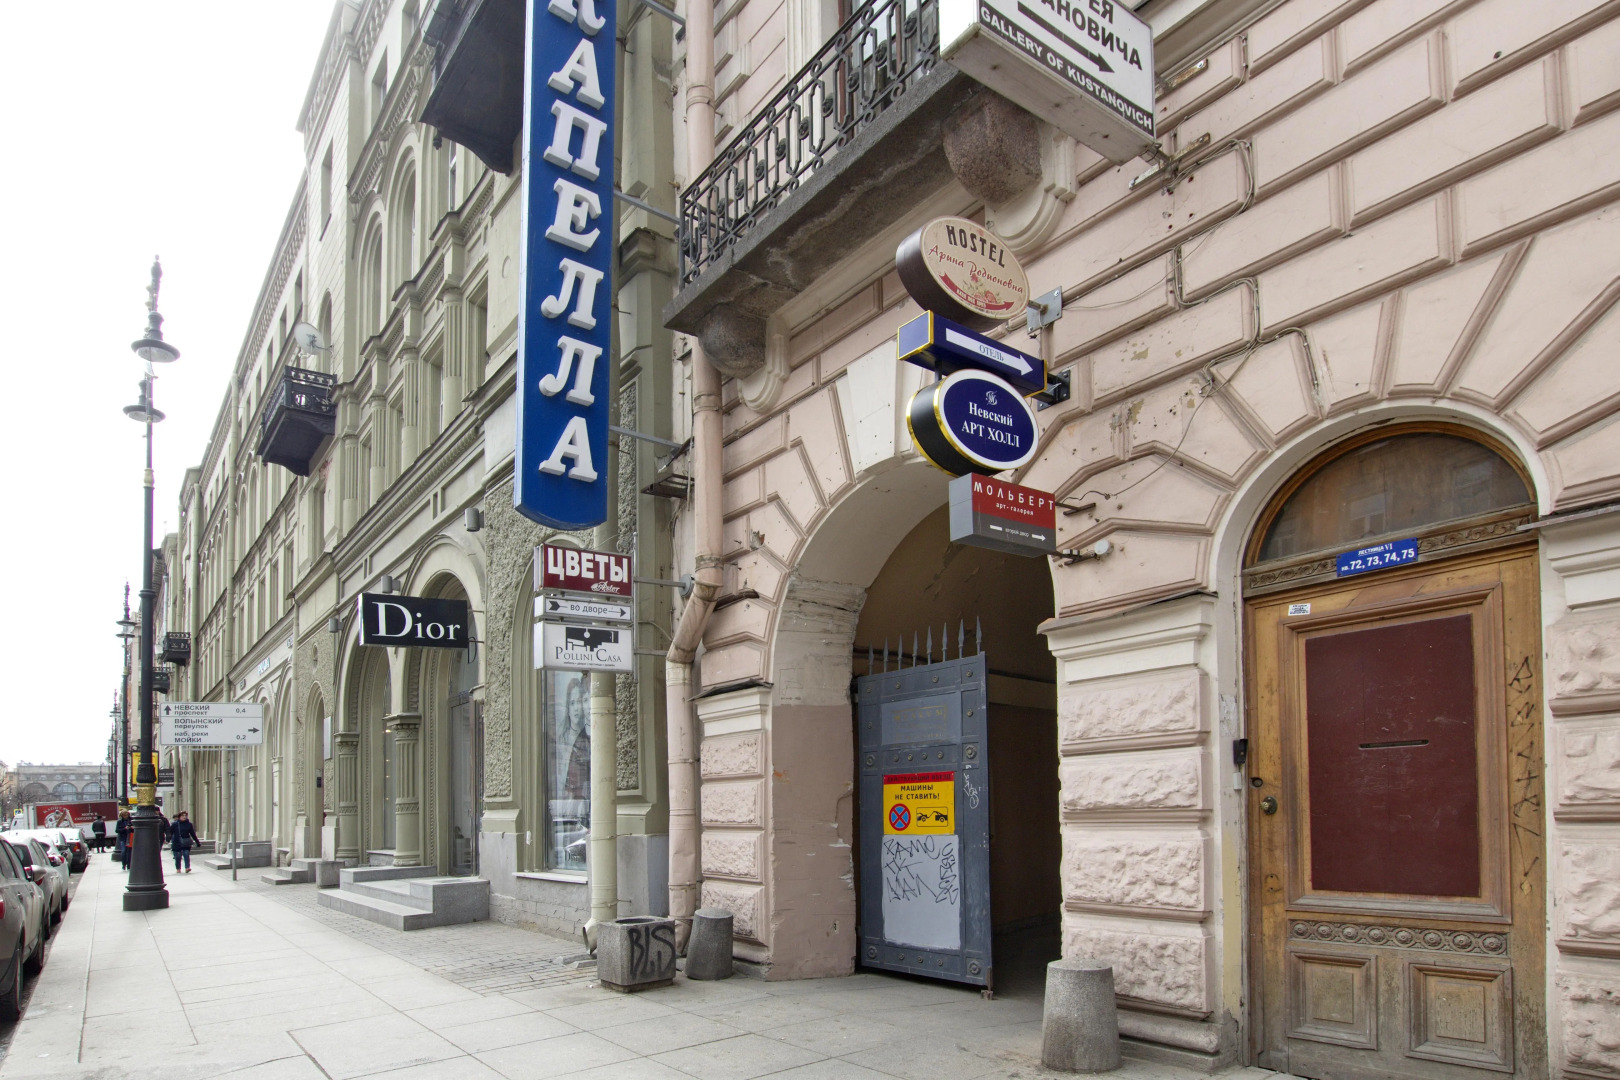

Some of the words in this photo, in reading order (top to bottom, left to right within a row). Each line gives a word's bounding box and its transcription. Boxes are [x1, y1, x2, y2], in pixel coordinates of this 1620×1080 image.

[981, 7, 1042, 58] GALLERY
[1047, 52, 1064, 70] OF
[1067, 65, 1152, 130] KUSTANOVICH
[946, 224, 1005, 268] HOSTEL
[928, 245, 964, 268] Арина
[967, 261, 1023, 293] Родионовна
[979, 344, 1004, 362] ОТЕЛЬ
[969, 402, 1013, 426] Невский
[962, 420, 984, 437] АРТ
[988, 427, 1020, 448] ХОЛЛ
[974, 482, 1053, 510] МОЛЬБЕРТ
[548, 548, 628, 583] ЦВЕТЫ
[1350, 560, 1365, 570] 72,
[1367, 556, 1382, 566] 73,
[1384, 552, 1400, 562] 74,
[1402, 548, 1415, 559] 75
[372, 602, 460, 640] Dior
[582, 605, 608, 615] дворе
